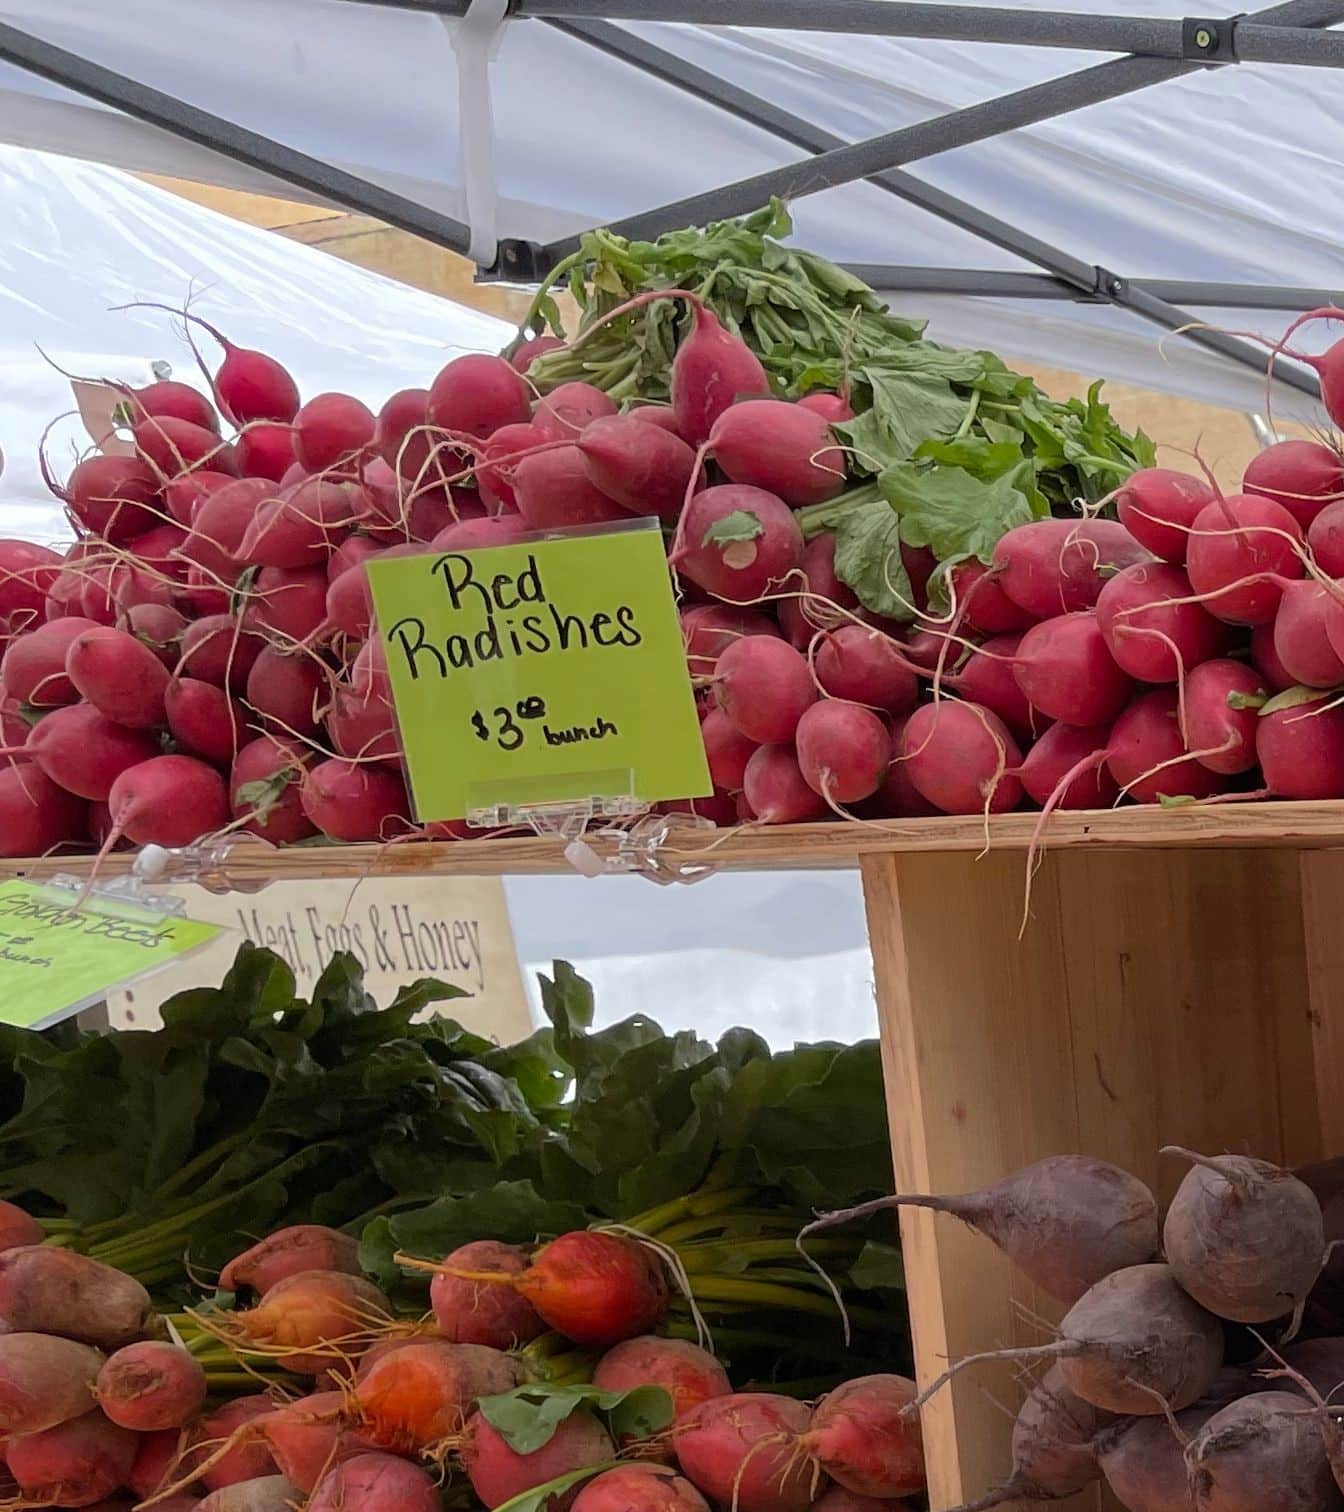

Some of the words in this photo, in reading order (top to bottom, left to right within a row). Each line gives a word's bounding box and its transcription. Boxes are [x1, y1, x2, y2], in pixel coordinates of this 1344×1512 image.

[431, 554, 546, 614] Red
[387, 604, 642, 680] Radishes
[543, 717, 618, 746] bunch
[84, 916, 175, 948] Beets
[368, 903, 397, 972] &
[391, 904, 485, 991] Honey
